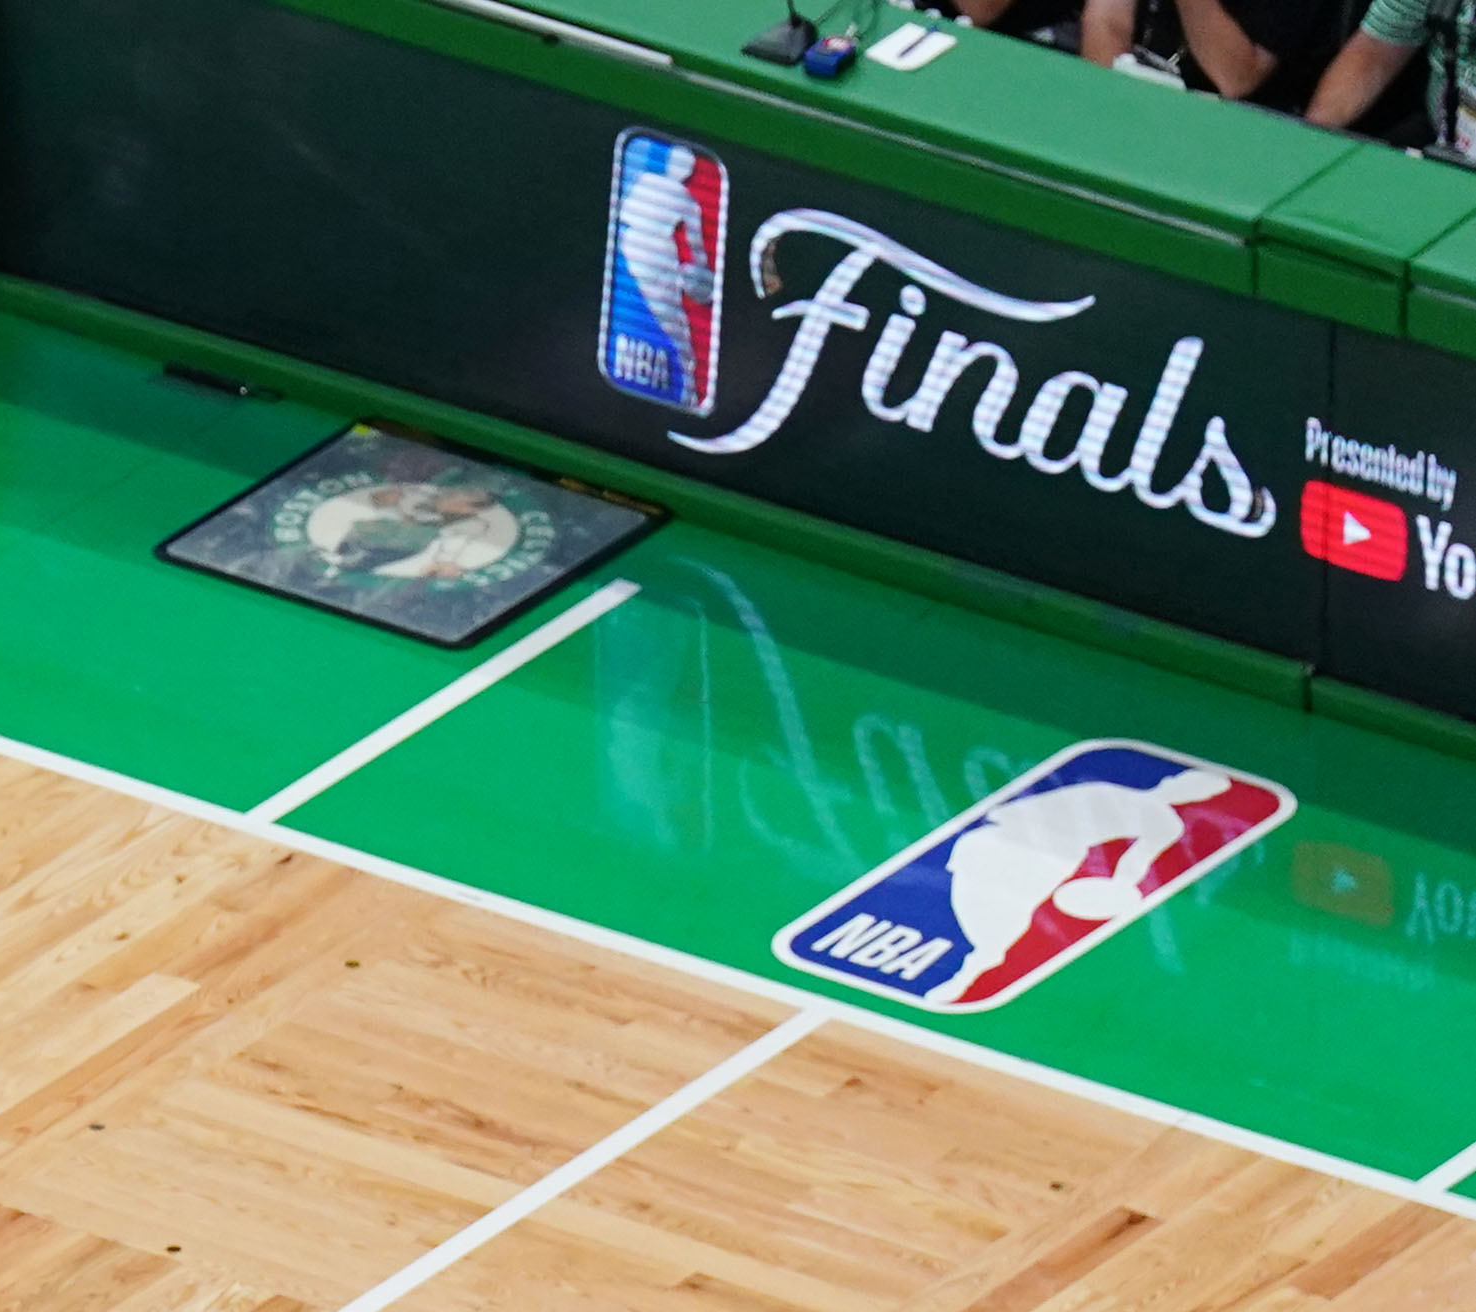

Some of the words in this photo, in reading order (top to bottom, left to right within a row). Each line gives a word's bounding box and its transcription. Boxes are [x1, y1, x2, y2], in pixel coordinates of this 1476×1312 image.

[613, 332, 670, 391] NBA
[667, 206, 1277, 538] Finals
[1304, 416, 1425, 497] Presented
[1425, 452, 1458, 512] by
[810, 911, 954, 981] NBA
